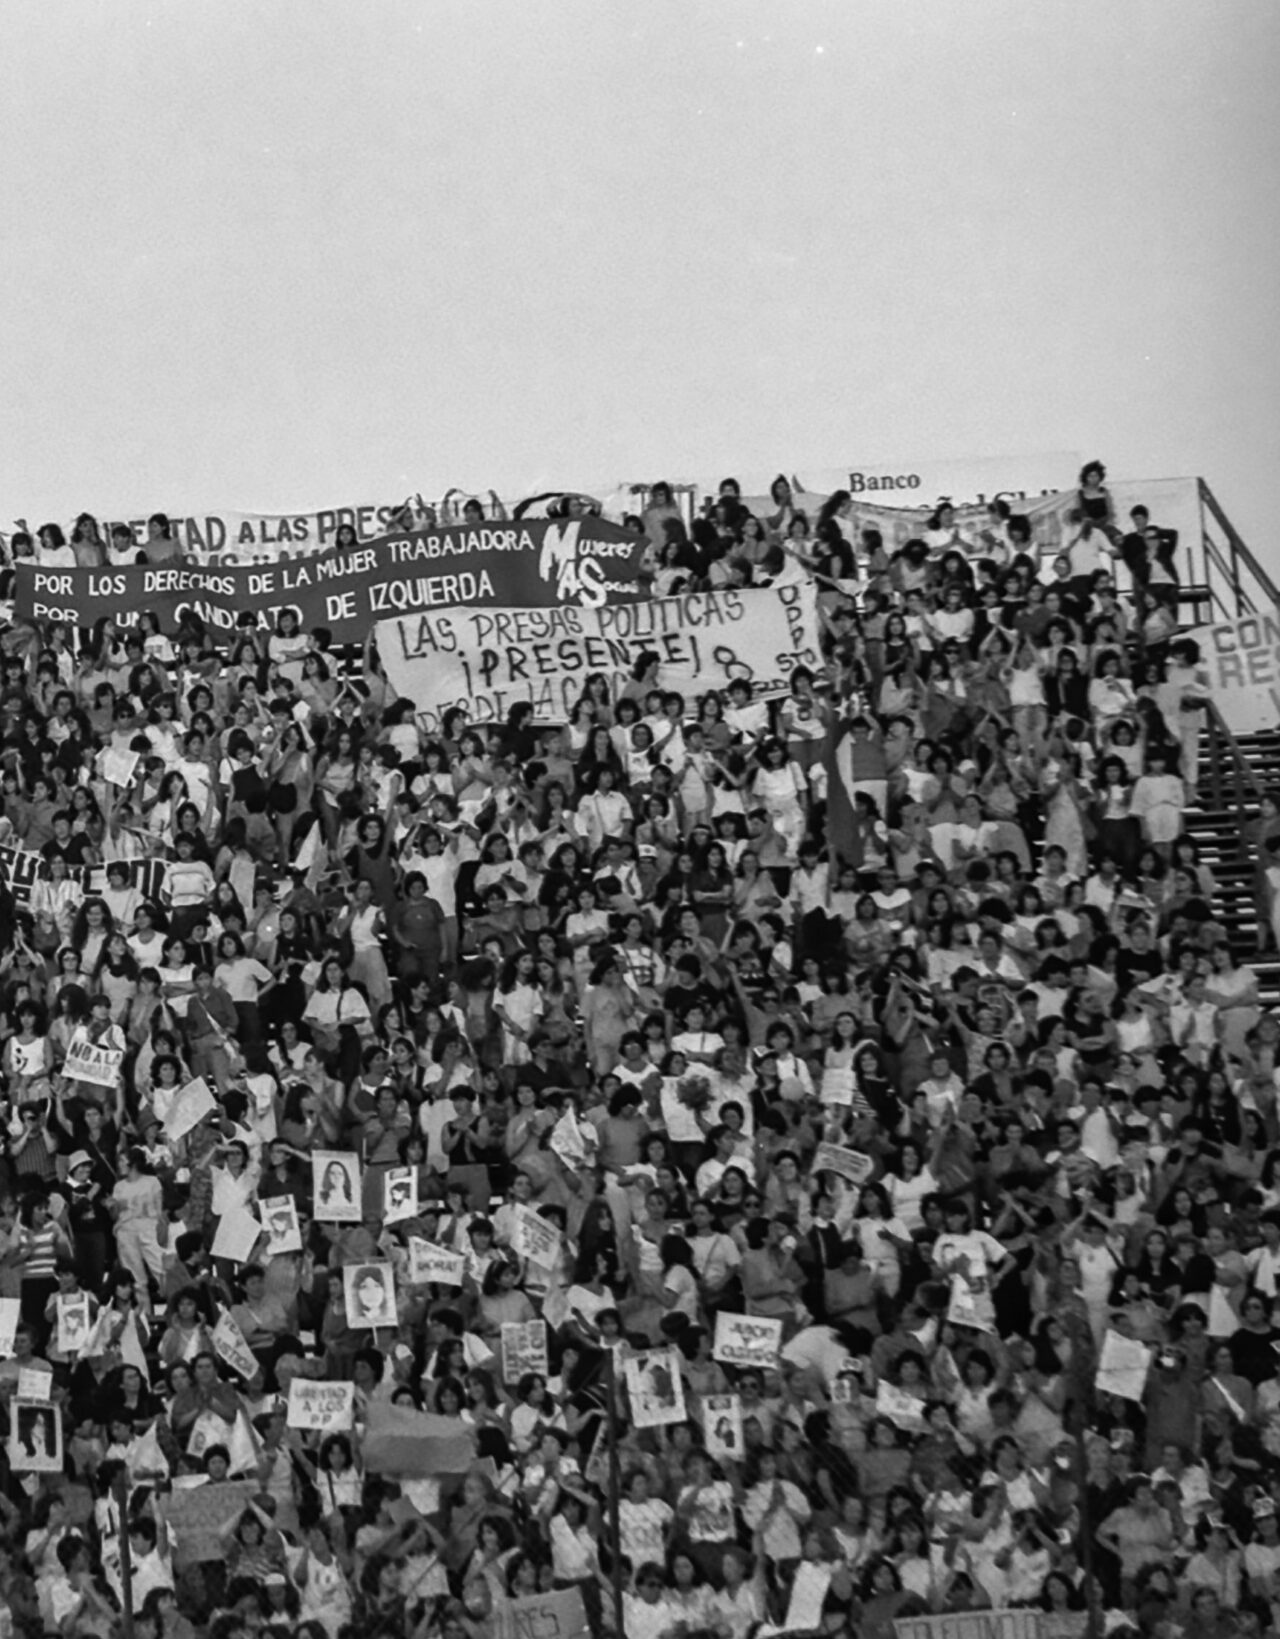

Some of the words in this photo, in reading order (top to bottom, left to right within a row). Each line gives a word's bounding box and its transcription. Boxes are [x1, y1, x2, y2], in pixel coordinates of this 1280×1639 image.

[848, 472, 921, 493] Banco
[238, 520, 255, 543] A
[259, 517, 309, 543] LAS
[34, 573, 73, 596] POR
[88, 574, 126, 597] LOS
[144, 569, 236, 596] DERECHOS
[248, 571, 274, 596] DE
[282, 566, 312, 590] LA
[317, 549, 378, 582] MUJER
[387, 529, 535, 563] TRABAJADORA
[33, 602, 80, 622] POR
[326, 591, 357, 621] DE
[369, 569, 495, 612] IZQUIERDA
[397, 617, 457, 660] LAS
[469, 608, 583, 647] PRESAS
[596, 590, 746, 638] POLITICAS
